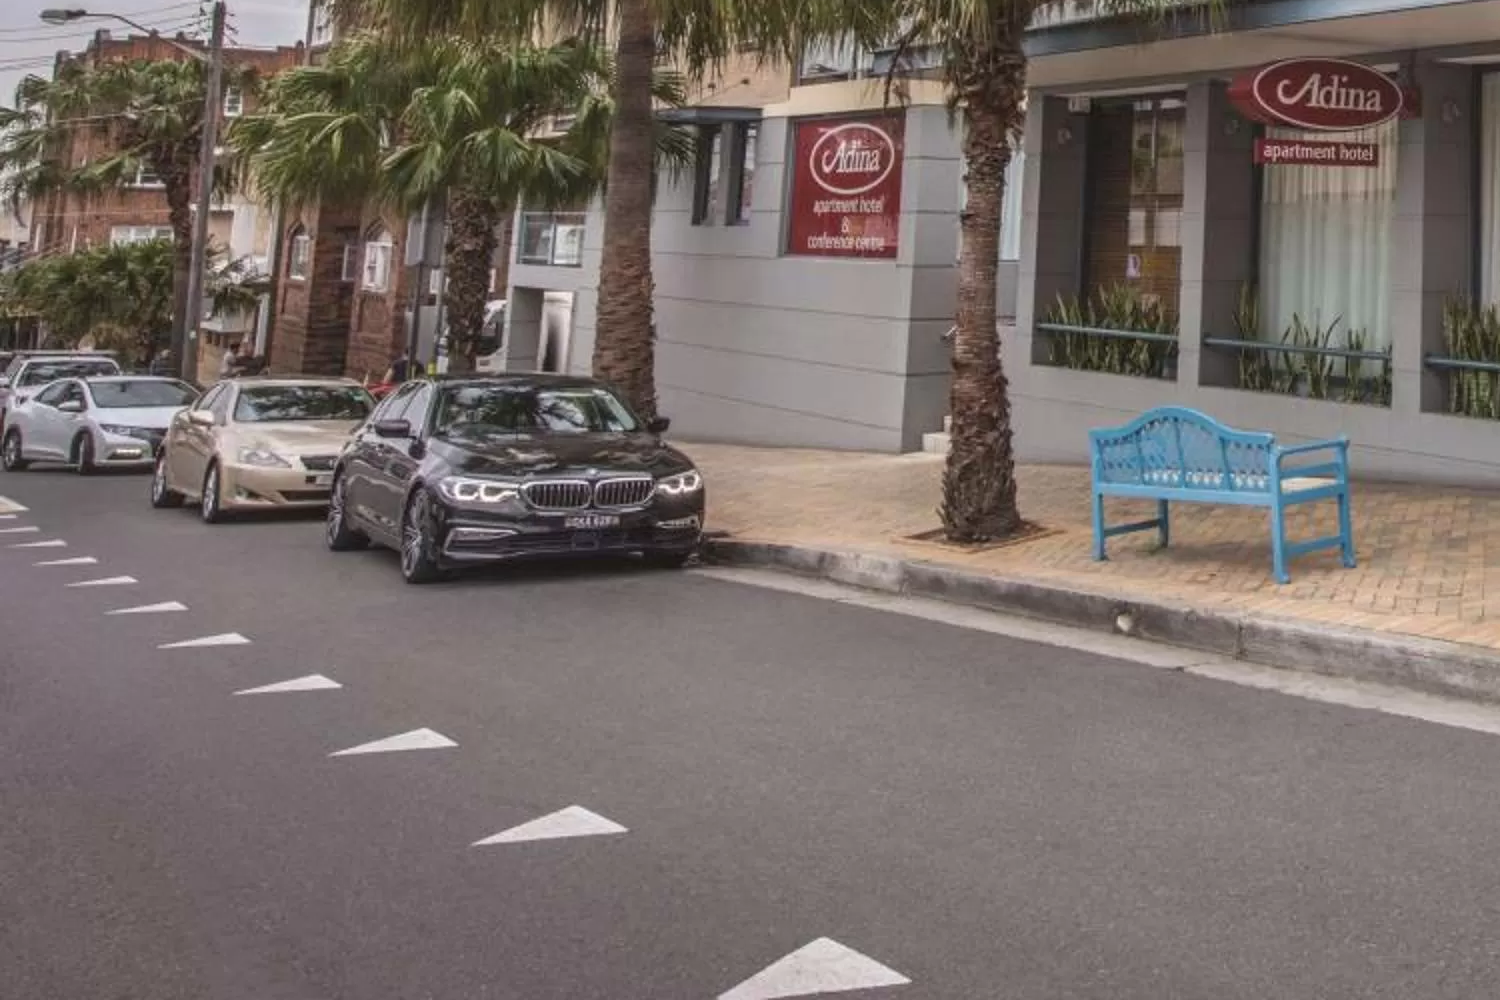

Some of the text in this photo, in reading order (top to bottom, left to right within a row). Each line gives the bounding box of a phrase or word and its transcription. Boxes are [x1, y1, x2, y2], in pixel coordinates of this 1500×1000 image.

[1276, 72, 1383, 112] Adina
[822, 139, 880, 173] Adina
[1263, 143, 1374, 163] apartment hotel
[813, 194, 884, 216] apartment hotel
[841, 215, 850, 233] &
[807, 231, 885, 252] conference centre
